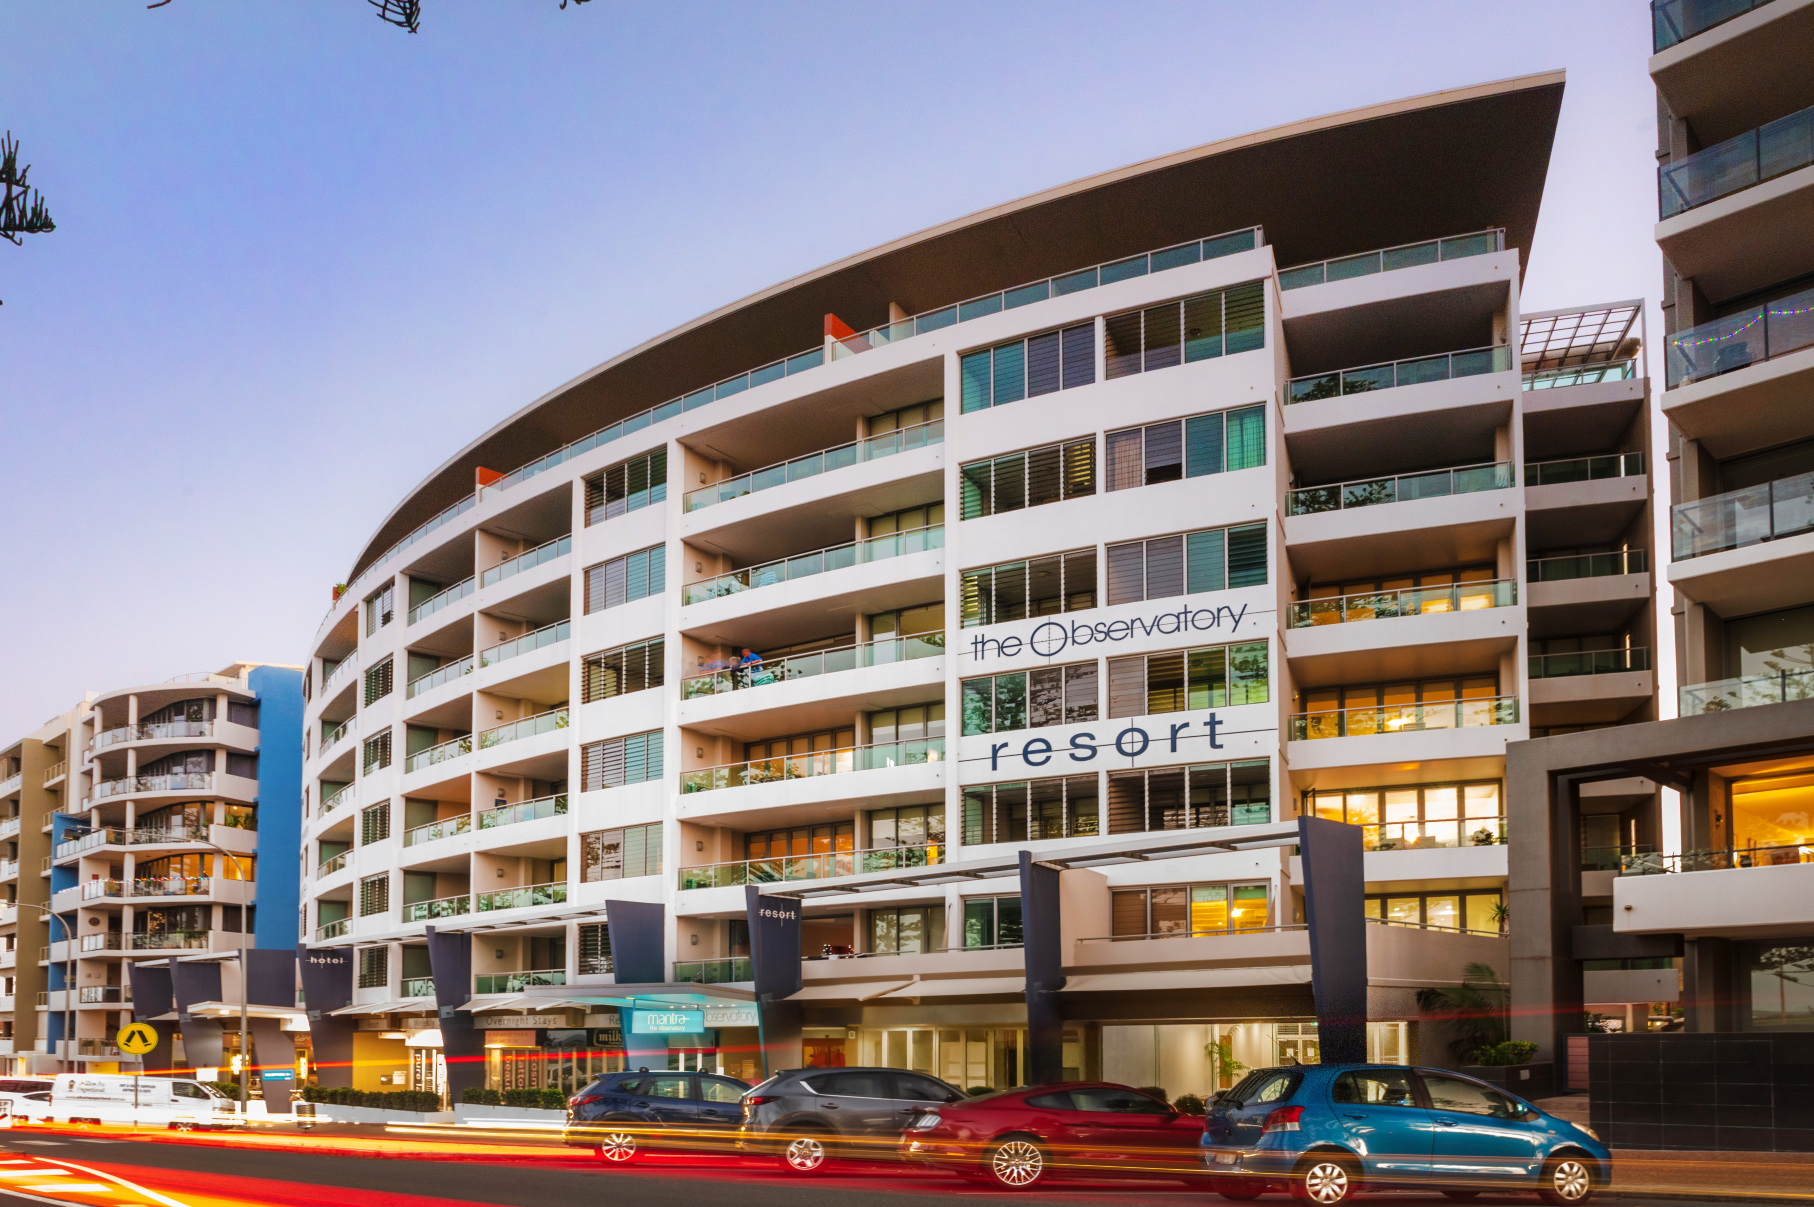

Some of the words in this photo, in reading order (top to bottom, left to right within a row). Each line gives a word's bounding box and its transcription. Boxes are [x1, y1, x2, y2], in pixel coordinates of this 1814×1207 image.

[970, 633, 1022, 661] the
[1030, 603, 1248, 657] Observatory
[990, 712, 1224, 771] resort
[760, 908, 796, 920] resort
[310, 956, 343, 964] hotel
[486, 1015, 529, 1027] Overnight
[532, 1015, 558, 1026] Stays
[647, 1013, 690, 1025] mantra
[704, 1009, 757, 1023] bservatory
[598, 1030, 622, 1042] milk
[414, 1053, 422, 1080] pure
